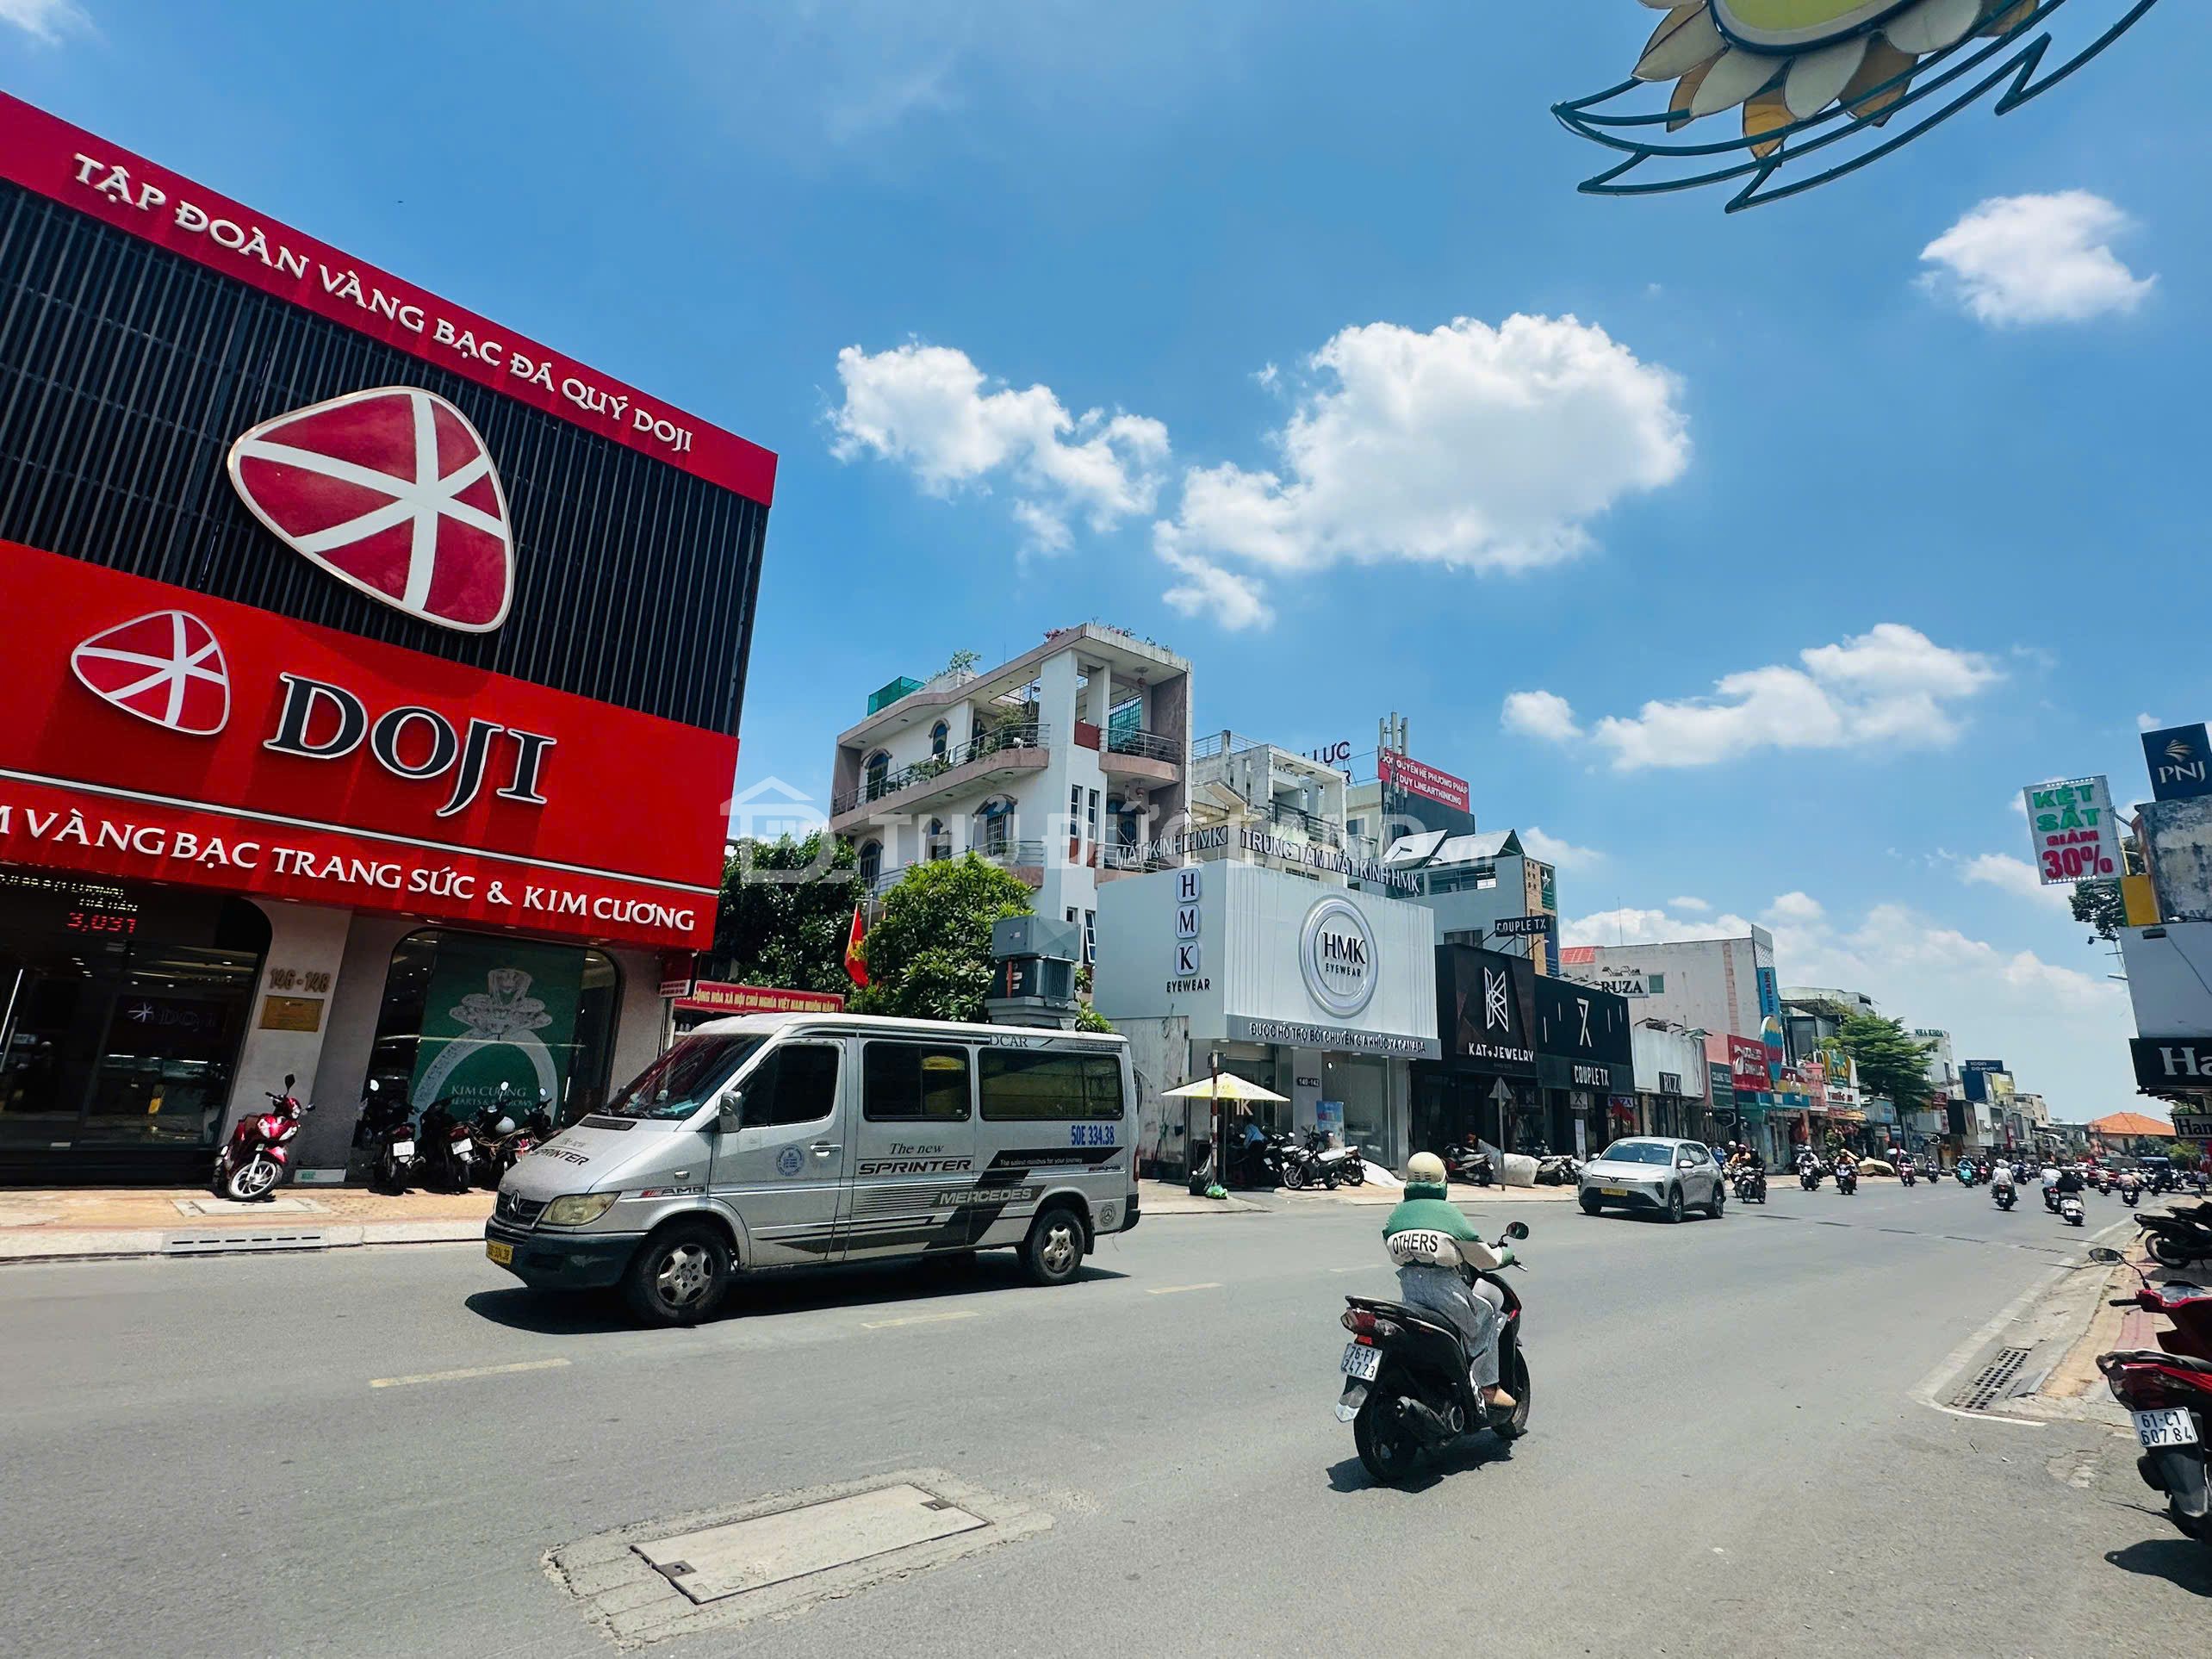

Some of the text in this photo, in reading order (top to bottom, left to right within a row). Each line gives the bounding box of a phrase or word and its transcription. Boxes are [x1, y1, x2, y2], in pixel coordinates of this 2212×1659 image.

[74, 152, 693, 454] TẬP ĐOÀN VÀNG BẠC ĐÁ QUÝ DOJI
[264, 672, 557, 817] DOJI
[2158, 761, 2206, 783] PNJ
[2033, 784, 2094, 808] KÉT
[2036, 805, 2100, 832] SẮT
[1185, 825, 1228, 853] HMK
[2047, 829, 2099, 846] GIẢM
[25, 808, 165, 854] VÀNG
[171, 832, 258, 868] BẠC
[272, 848, 402, 890] TRANG
[409, 867, 475, 901] SỨC
[488, 882, 512, 904] &
[524, 885, 588, 916] KIM
[593, 894, 696, 931] CƯƠNG
[1241, 829, 1293, 861] TRUNG
[1392, 868, 1420, 892] HMK
[2042, 844, 2113, 879] 30%
[1496, 918, 1547, 932] COUPLE TX
[1322, 932, 1366, 964] HMK
[1326, 963, 1362, 977] EYEWEAR
[1166, 979, 1211, 993] EYEWEAR
[1600, 980, 1643, 994] RUZA
[1250, 1022, 1276, 1040] ĐƯỢC
[1469, 1041, 1534, 1062] KAT JEWELRY
[1574, 1065, 1610, 1086] COUPLE TX
[1071, 1125, 1115, 1146] 50E 334.38
[891, 1143, 944, 1155] The new
[858, 1159, 972, 1175] SPRINTER
[939, 1188, 1033, 1205] MERCEDES
[1392, 1233, 1438, 1255] OTHERS
[1349, 1345, 1375, 1363] 76-F1
[1341, 1359, 1376, 1378] 247.23
[2141, 1412, 2181, 1428] 61-C1
[2141, 1426, 2193, 1445] 607.84
